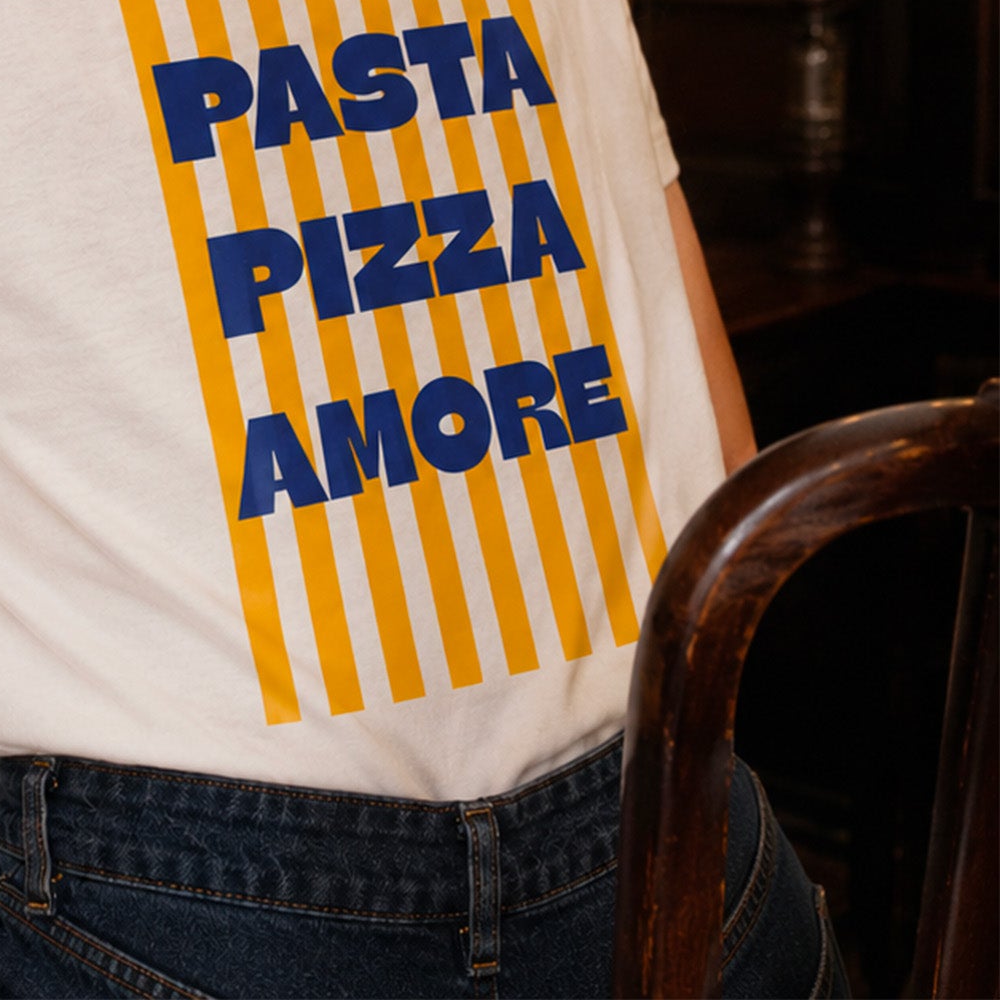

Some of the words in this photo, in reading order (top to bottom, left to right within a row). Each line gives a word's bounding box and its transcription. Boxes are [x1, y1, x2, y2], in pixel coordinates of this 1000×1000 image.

[152, 16, 555, 163] PASTA
[207, 178, 585, 339] PIZZA
[238, 345, 627, 520] AMORE
